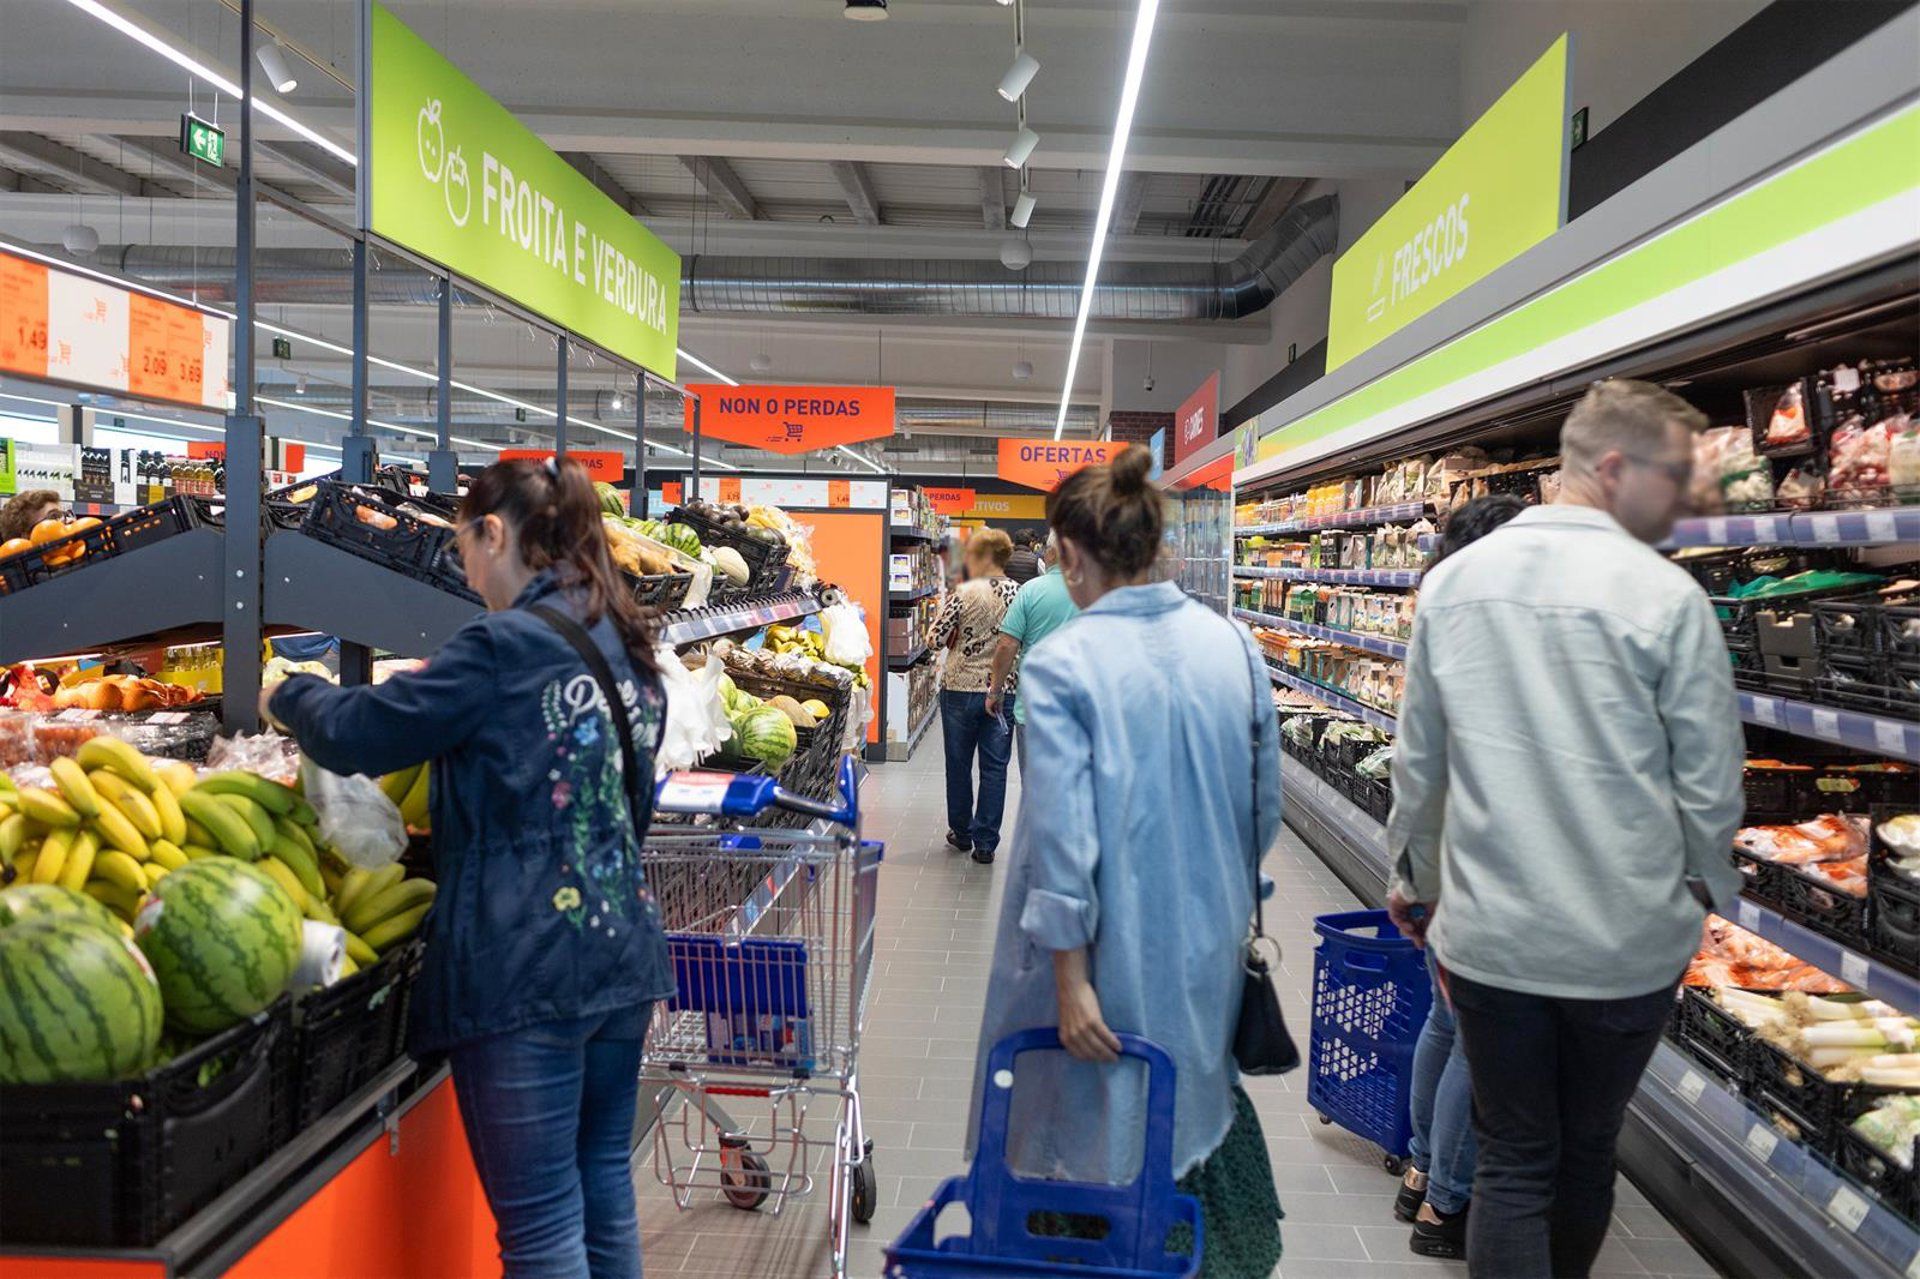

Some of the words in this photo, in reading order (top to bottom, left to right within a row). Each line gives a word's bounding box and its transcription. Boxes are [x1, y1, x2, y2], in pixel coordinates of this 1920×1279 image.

[482, 151, 568, 276] FROITA
[574, 220, 587, 286] E
[592, 233, 667, 336] VERDURA
[1391, 192, 1470, 307] FRESCOS
[719, 398, 761, 414] NON
[766, 399, 778, 414] O
[784, 399, 860, 417] PERDAS
[1020, 446, 1106, 464] OFERTAS
